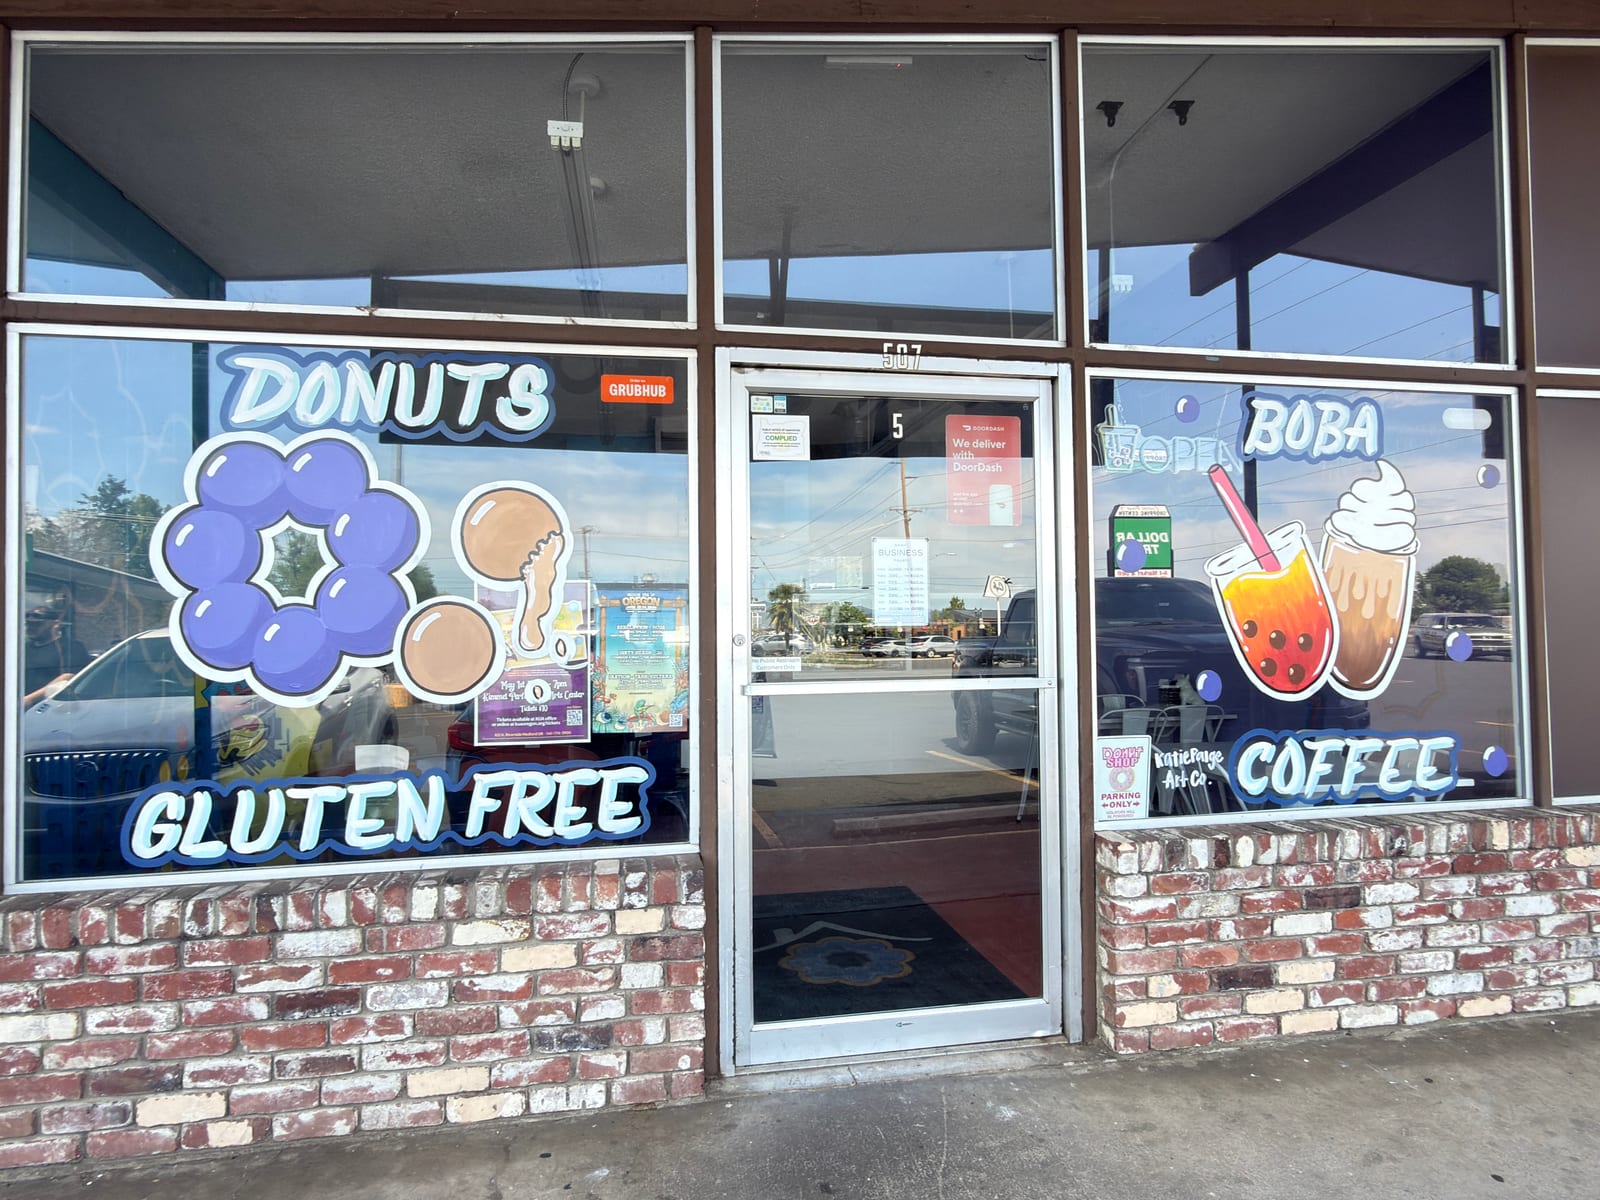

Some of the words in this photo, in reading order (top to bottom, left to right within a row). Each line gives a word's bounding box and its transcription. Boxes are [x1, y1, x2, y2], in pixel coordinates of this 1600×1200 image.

[883, 342, 922, 370] 507
[228, 355, 551, 432] DONUTS
[609, 383, 666, 397] GRUBHUB
[892, 413, 903, 438] 5
[1244, 400, 1378, 457] BOBA
[952, 438, 970, 448] We
[972, 439, 1006, 449] deliver
[952, 450, 974, 460] with
[952, 462, 1002, 472] DoorDash
[878, 549, 924, 557] BUSINESS
[622, 596, 660, 606] OREGON
[501, 681, 515, 692] May
[552, 679, 568, 689] 7pm
[1106, 758, 1139, 768] SHOP
[1238, 737, 1452, 795] COFFEE
[1162, 770, 1188, 789] Art
[1190, 770, 1213, 787] Co.
[1101, 792, 1141, 800] PARKING
[132, 777, 444, 858] GLUTEN
[466, 765, 649, 840] FREE
[1109, 801, 1133, 809] ONLY
